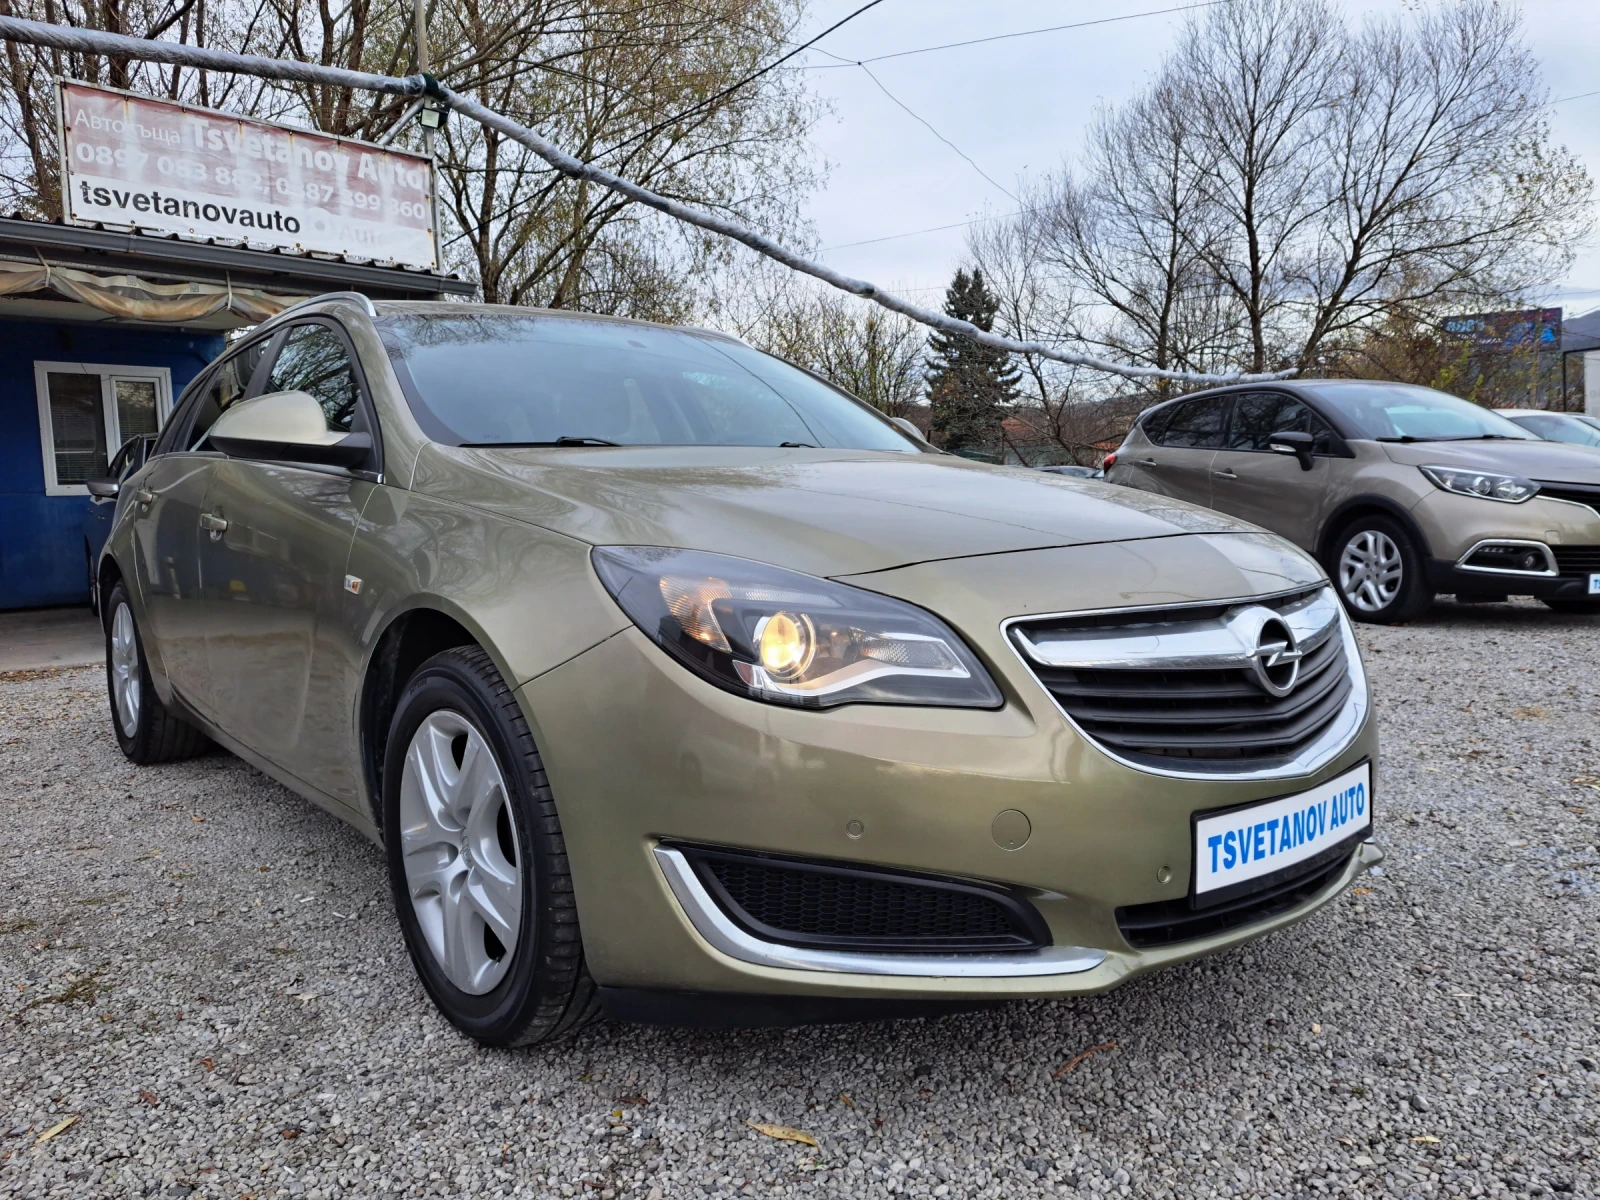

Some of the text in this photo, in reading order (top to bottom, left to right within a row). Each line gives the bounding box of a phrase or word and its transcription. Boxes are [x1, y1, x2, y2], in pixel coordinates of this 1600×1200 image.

[187, 117, 424, 190] Tsvetanov Auto
[79, 180, 300, 234] tsvetanovauto
[1207, 782, 1365, 874] TSVETANOV AUTO
